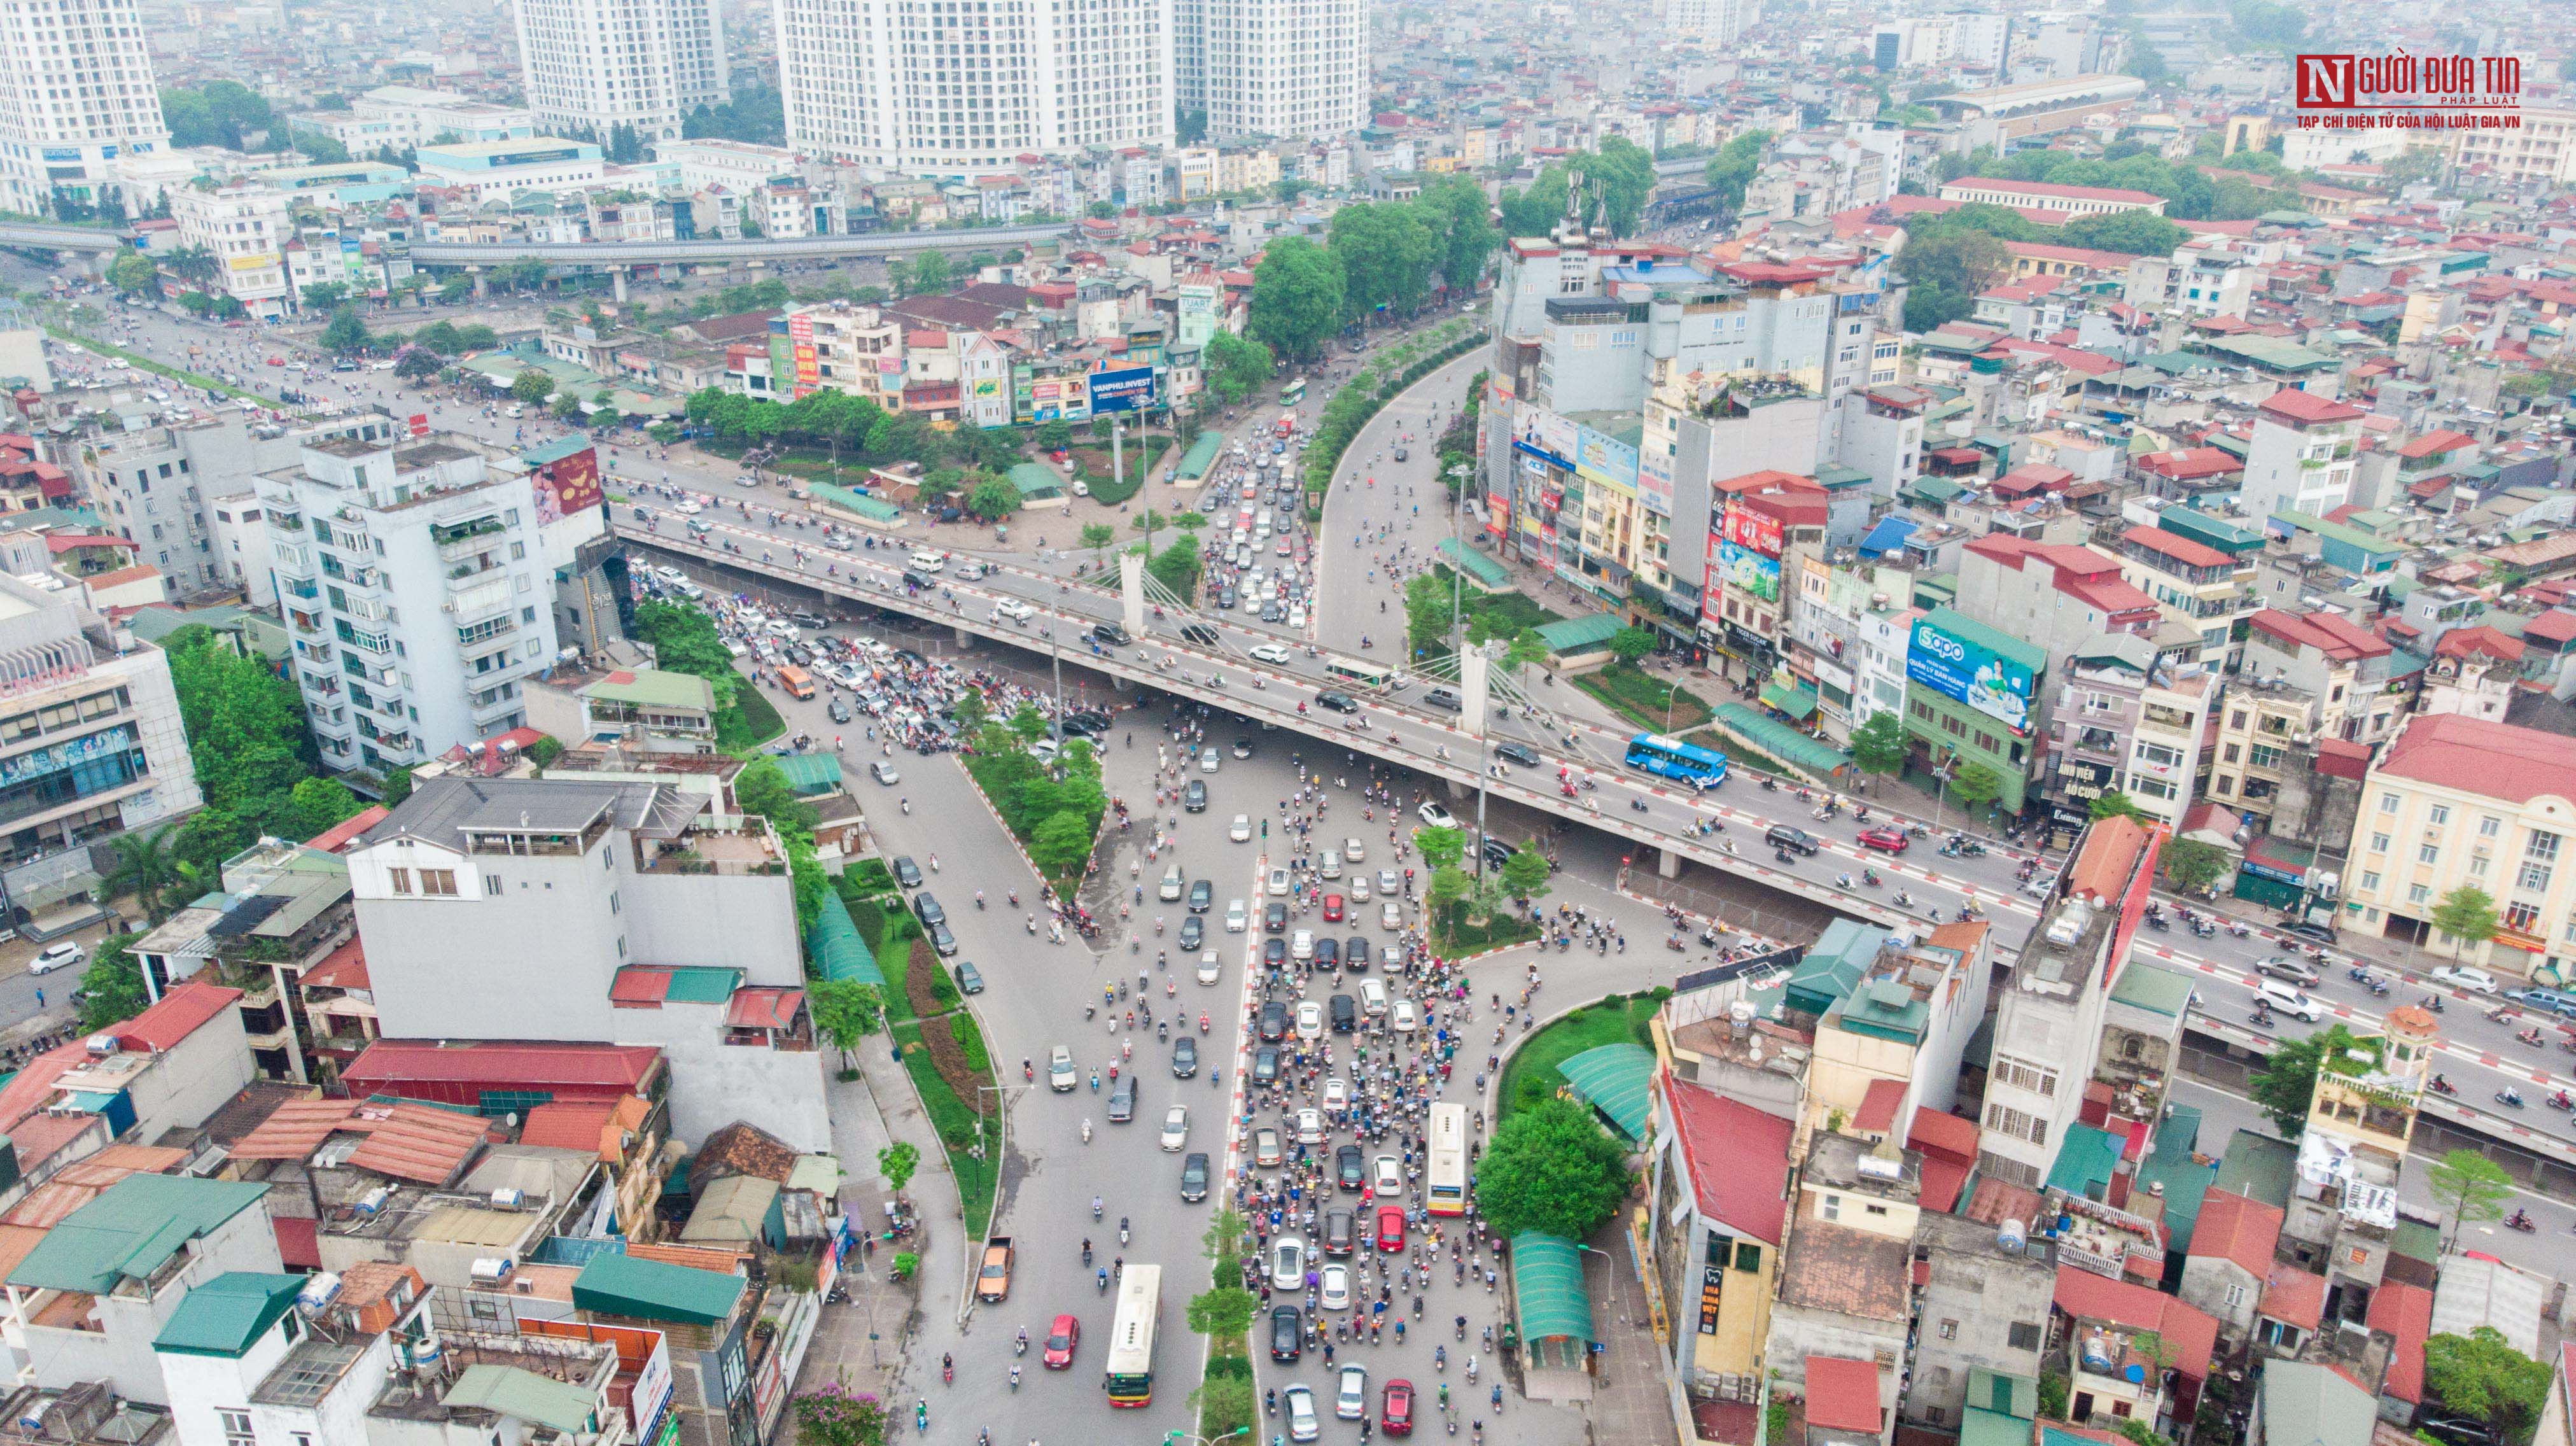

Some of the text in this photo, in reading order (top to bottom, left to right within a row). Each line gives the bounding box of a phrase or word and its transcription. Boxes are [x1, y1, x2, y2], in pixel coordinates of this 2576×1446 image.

[1093, 378, 1151, 392] VANPHU.INVEST
[1736, 627, 1749, 638] TIGER
[2076, 765, 2096, 783] VIỆN
[2064, 780, 2078, 796] ÁO
[1702, 1304, 1718, 1314] VIỆT
